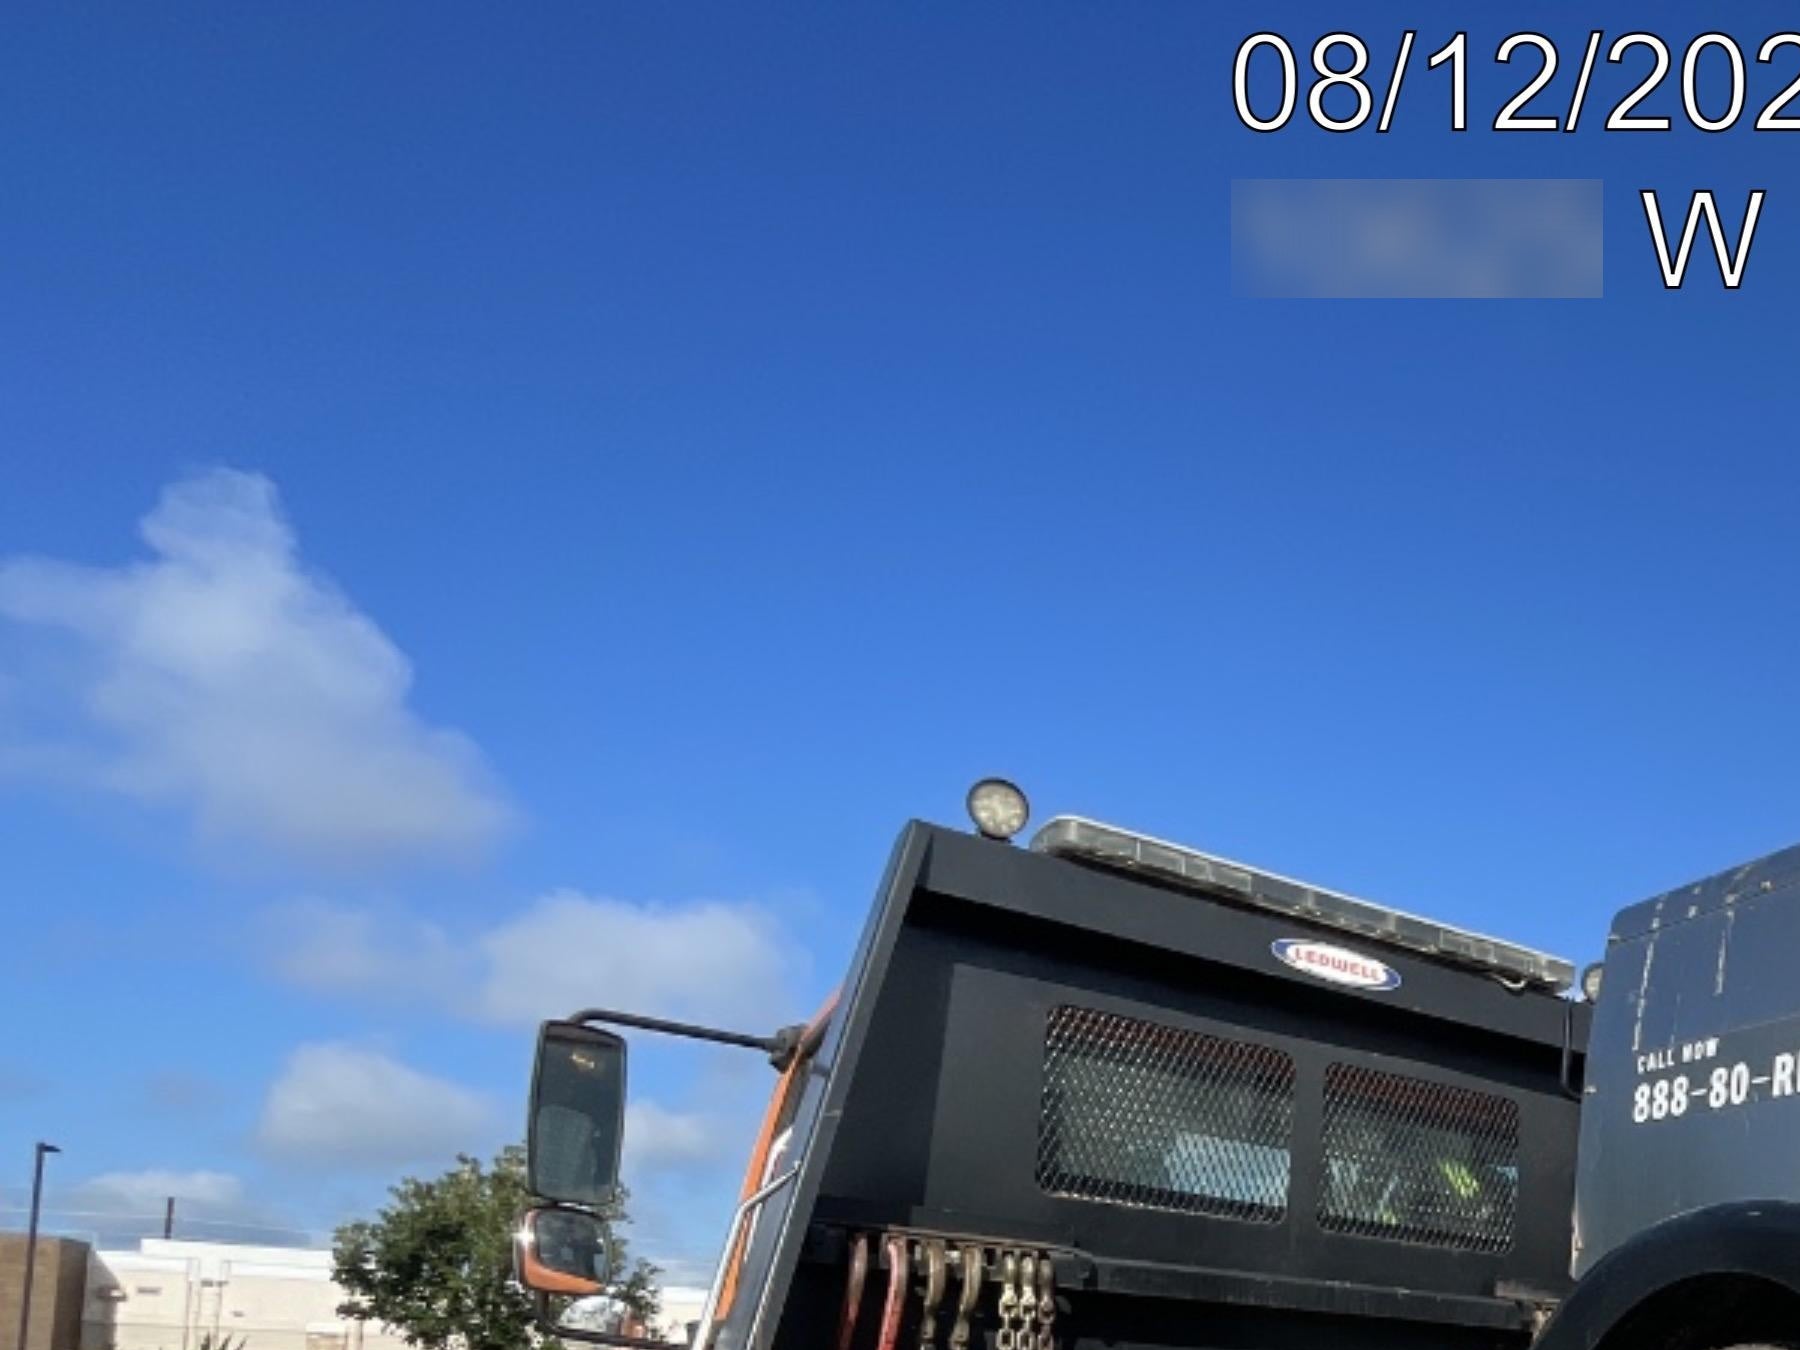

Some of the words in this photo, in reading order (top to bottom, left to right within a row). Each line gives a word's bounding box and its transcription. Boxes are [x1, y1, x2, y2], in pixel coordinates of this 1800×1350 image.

[1294, 947, 1382, 982] LEDWELL
[1637, 1048, 1675, 1075] CALL
[1681, 1036, 1720, 1064] NOW
